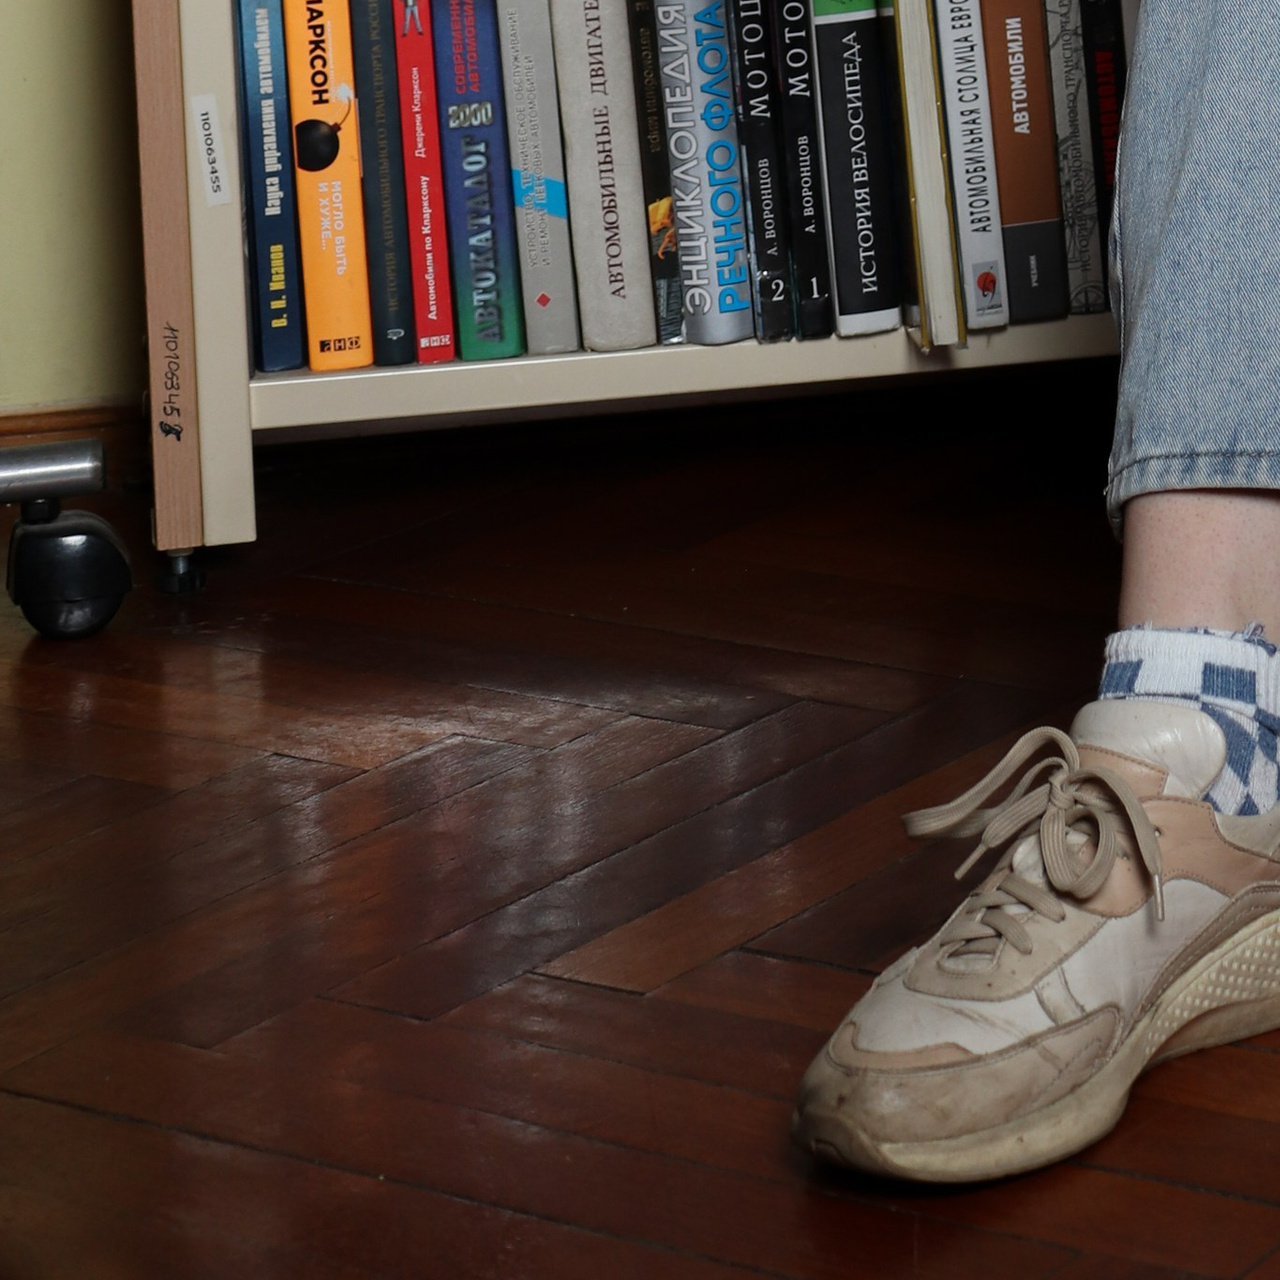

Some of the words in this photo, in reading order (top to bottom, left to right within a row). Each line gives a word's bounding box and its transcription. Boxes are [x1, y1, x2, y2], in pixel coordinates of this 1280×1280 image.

[254, 8, 274, 94] автомобилем
[410, 67, 423, 112] Кларксон
[694, 0, 737, 130] ФЛОТА
[956, 34, 980, 102] СТОЛИЦА
[1005, 17, 1030, 134] АВТОМОБИЛИ
[259, 99, 283, 173] управления
[415, 115, 426, 157] Джереми
[841, 32, 868, 182] ВЕЛОСИПЕДА
[202, 111, 222, 193] 1101063455
[659, 4, 711, 315] ЭНЦИКЛОПЕДИЯ
[798, 136, 814, 215] ВОРОНЦОВ
[963, 108, 992, 233] АВТОМОБИЛЬНАЯ
[261, 177, 283, 215] Наука
[418, 176, 434, 233] Кларксону
[594, 106, 626, 300] АВТОМОБИЛЬНЫЕ
[706, 140, 750, 312] РЕЧНОГО
[758, 158, 776, 238] ВОРОНЦОВ
[268, 244, 285, 290] Иванов
[424, 237, 434, 250] по
[461, 136, 502, 343] АВТОКАТАЛОГ
[851, 188, 879, 293] ИСТОРИЯ
[424, 253, 438, 320] Автомобили
